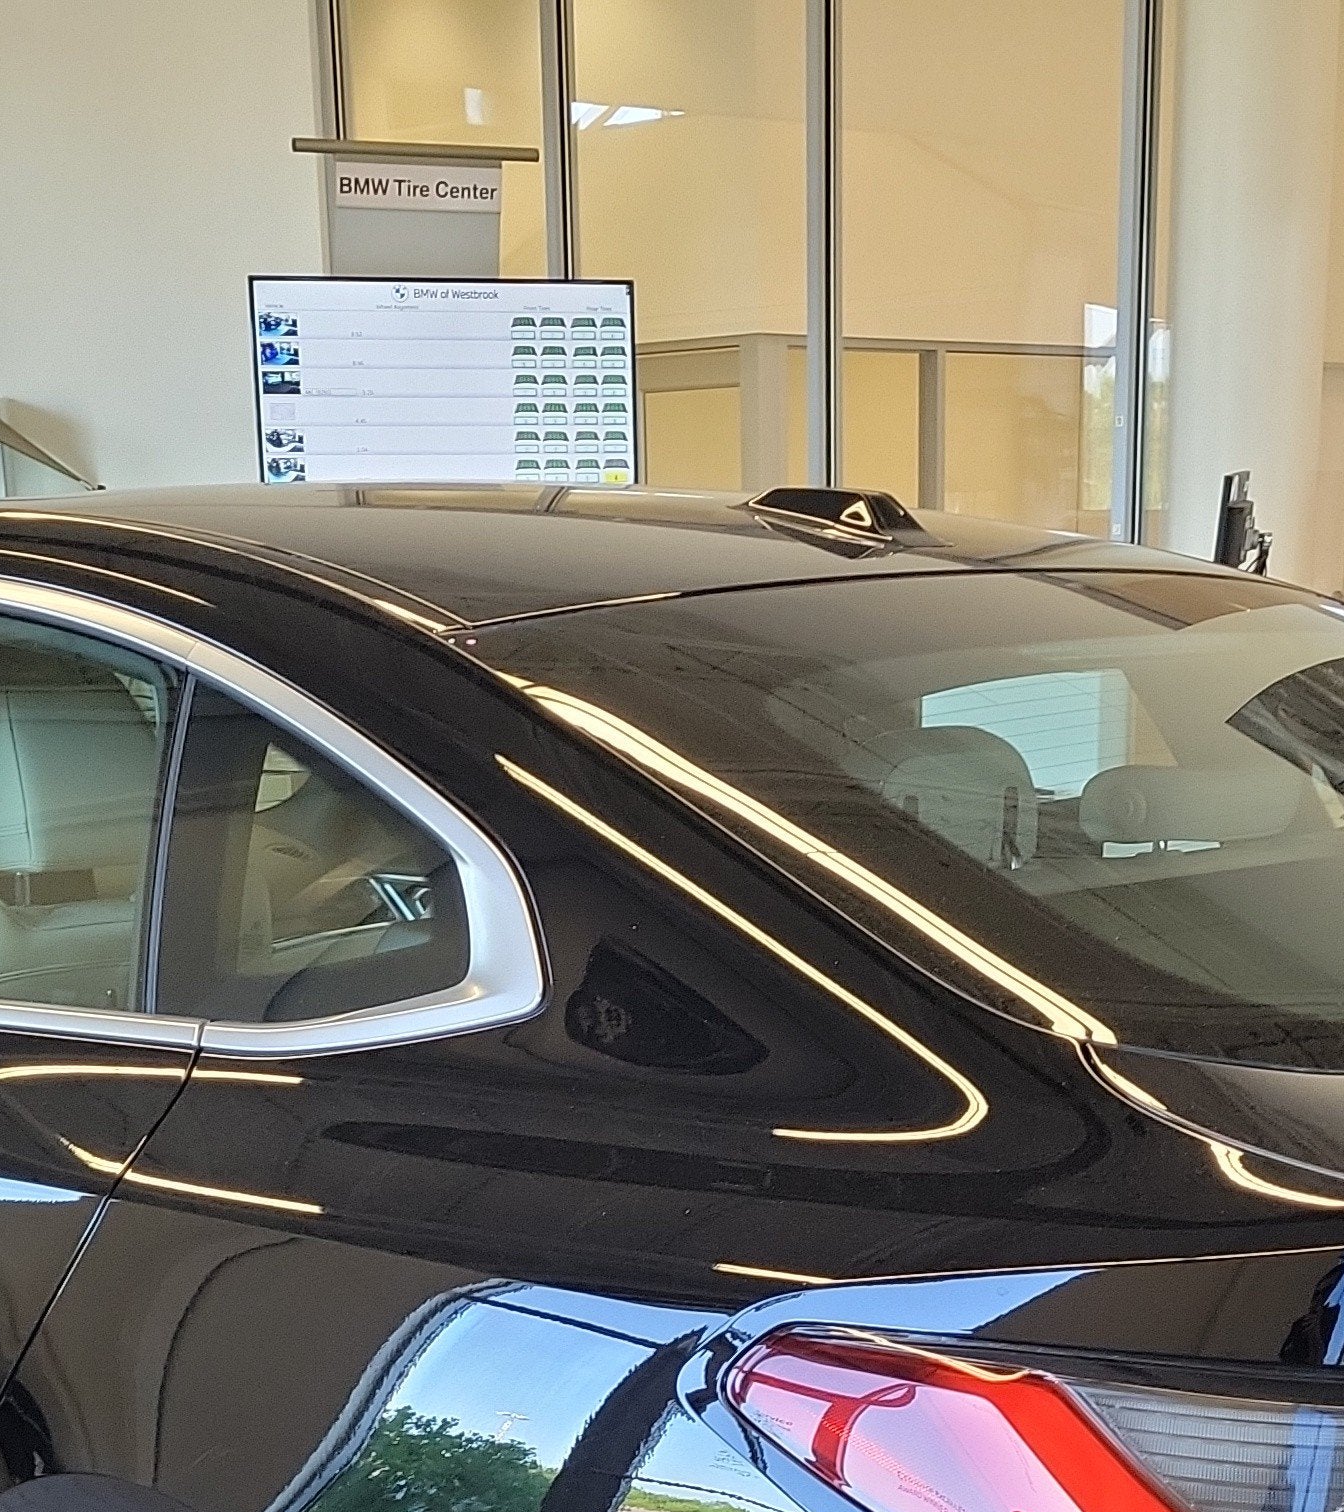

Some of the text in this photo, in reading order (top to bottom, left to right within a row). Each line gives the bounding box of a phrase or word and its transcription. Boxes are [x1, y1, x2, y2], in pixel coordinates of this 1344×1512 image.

[339, 176, 498, 200] BMW Tire Center
[413, 288, 500, 300] BMW of Westbrook
